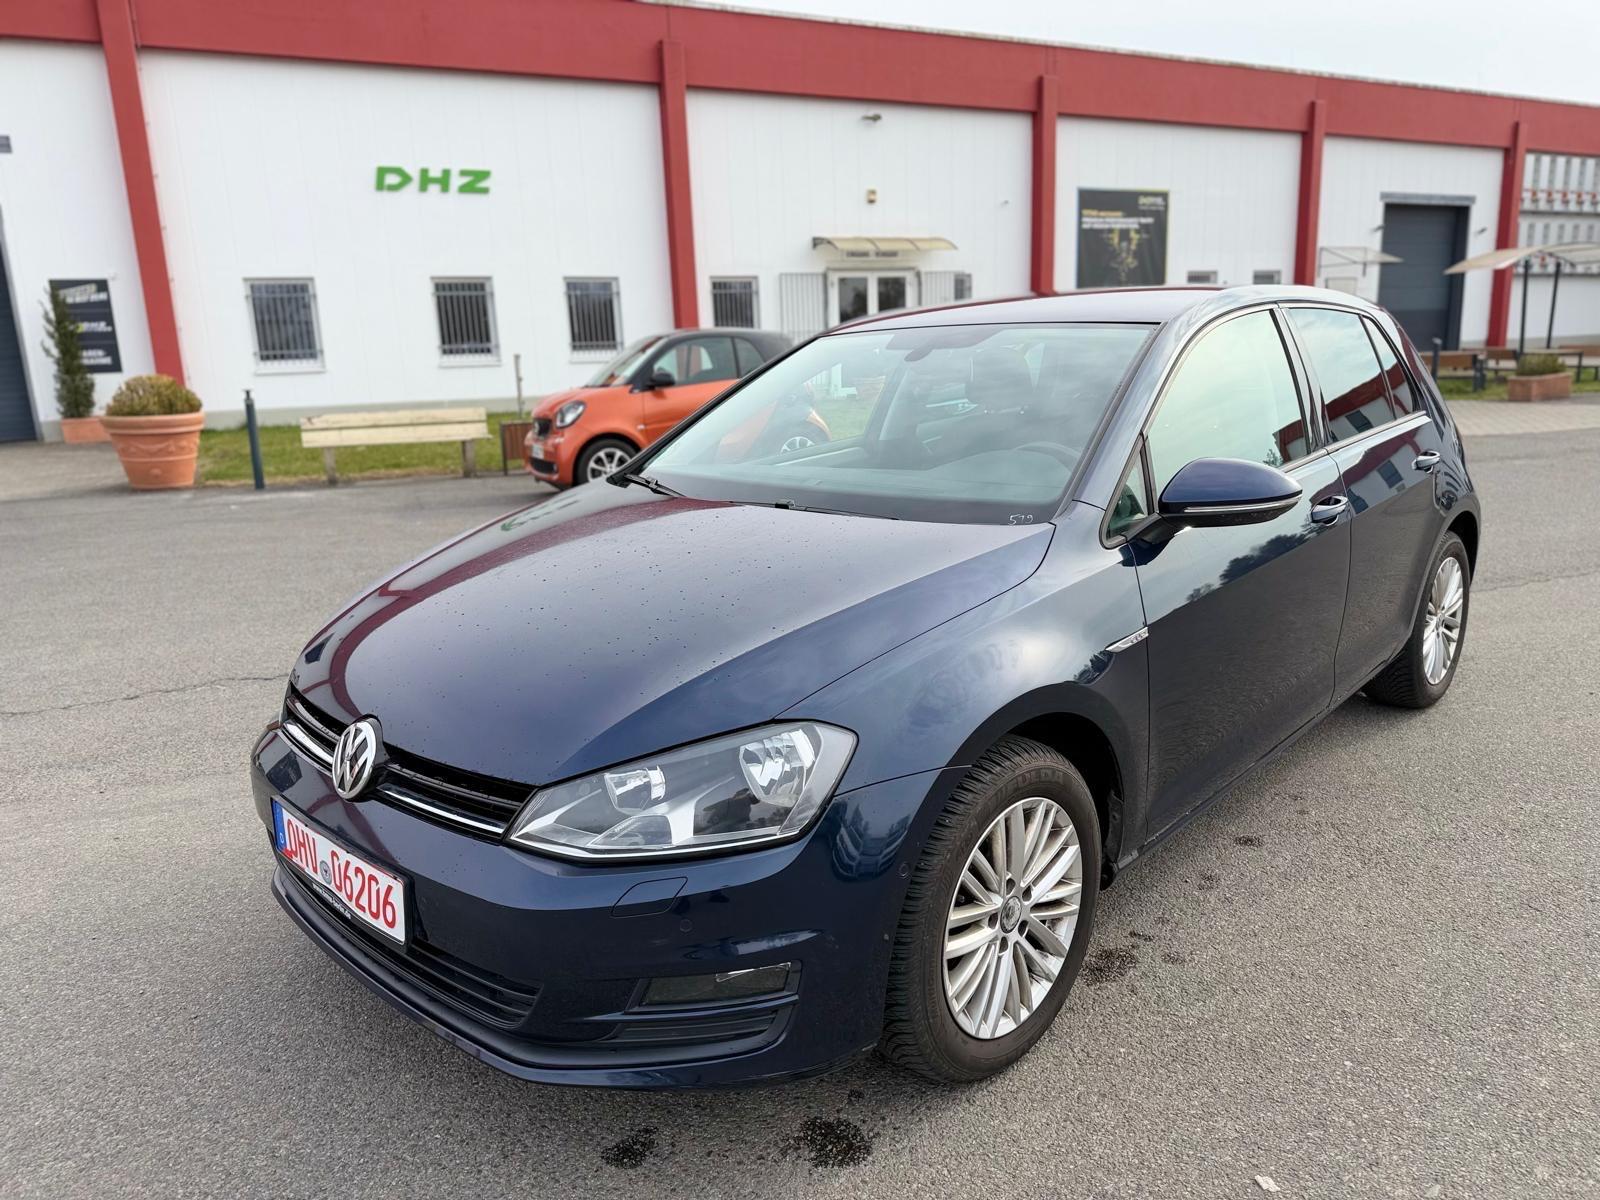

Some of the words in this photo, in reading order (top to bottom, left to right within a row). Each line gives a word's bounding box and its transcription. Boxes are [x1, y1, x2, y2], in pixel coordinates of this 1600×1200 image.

[375, 166, 491, 194] DHZ
[287, 818, 318, 875] OHV
[330, 850, 397, 929] 06206
